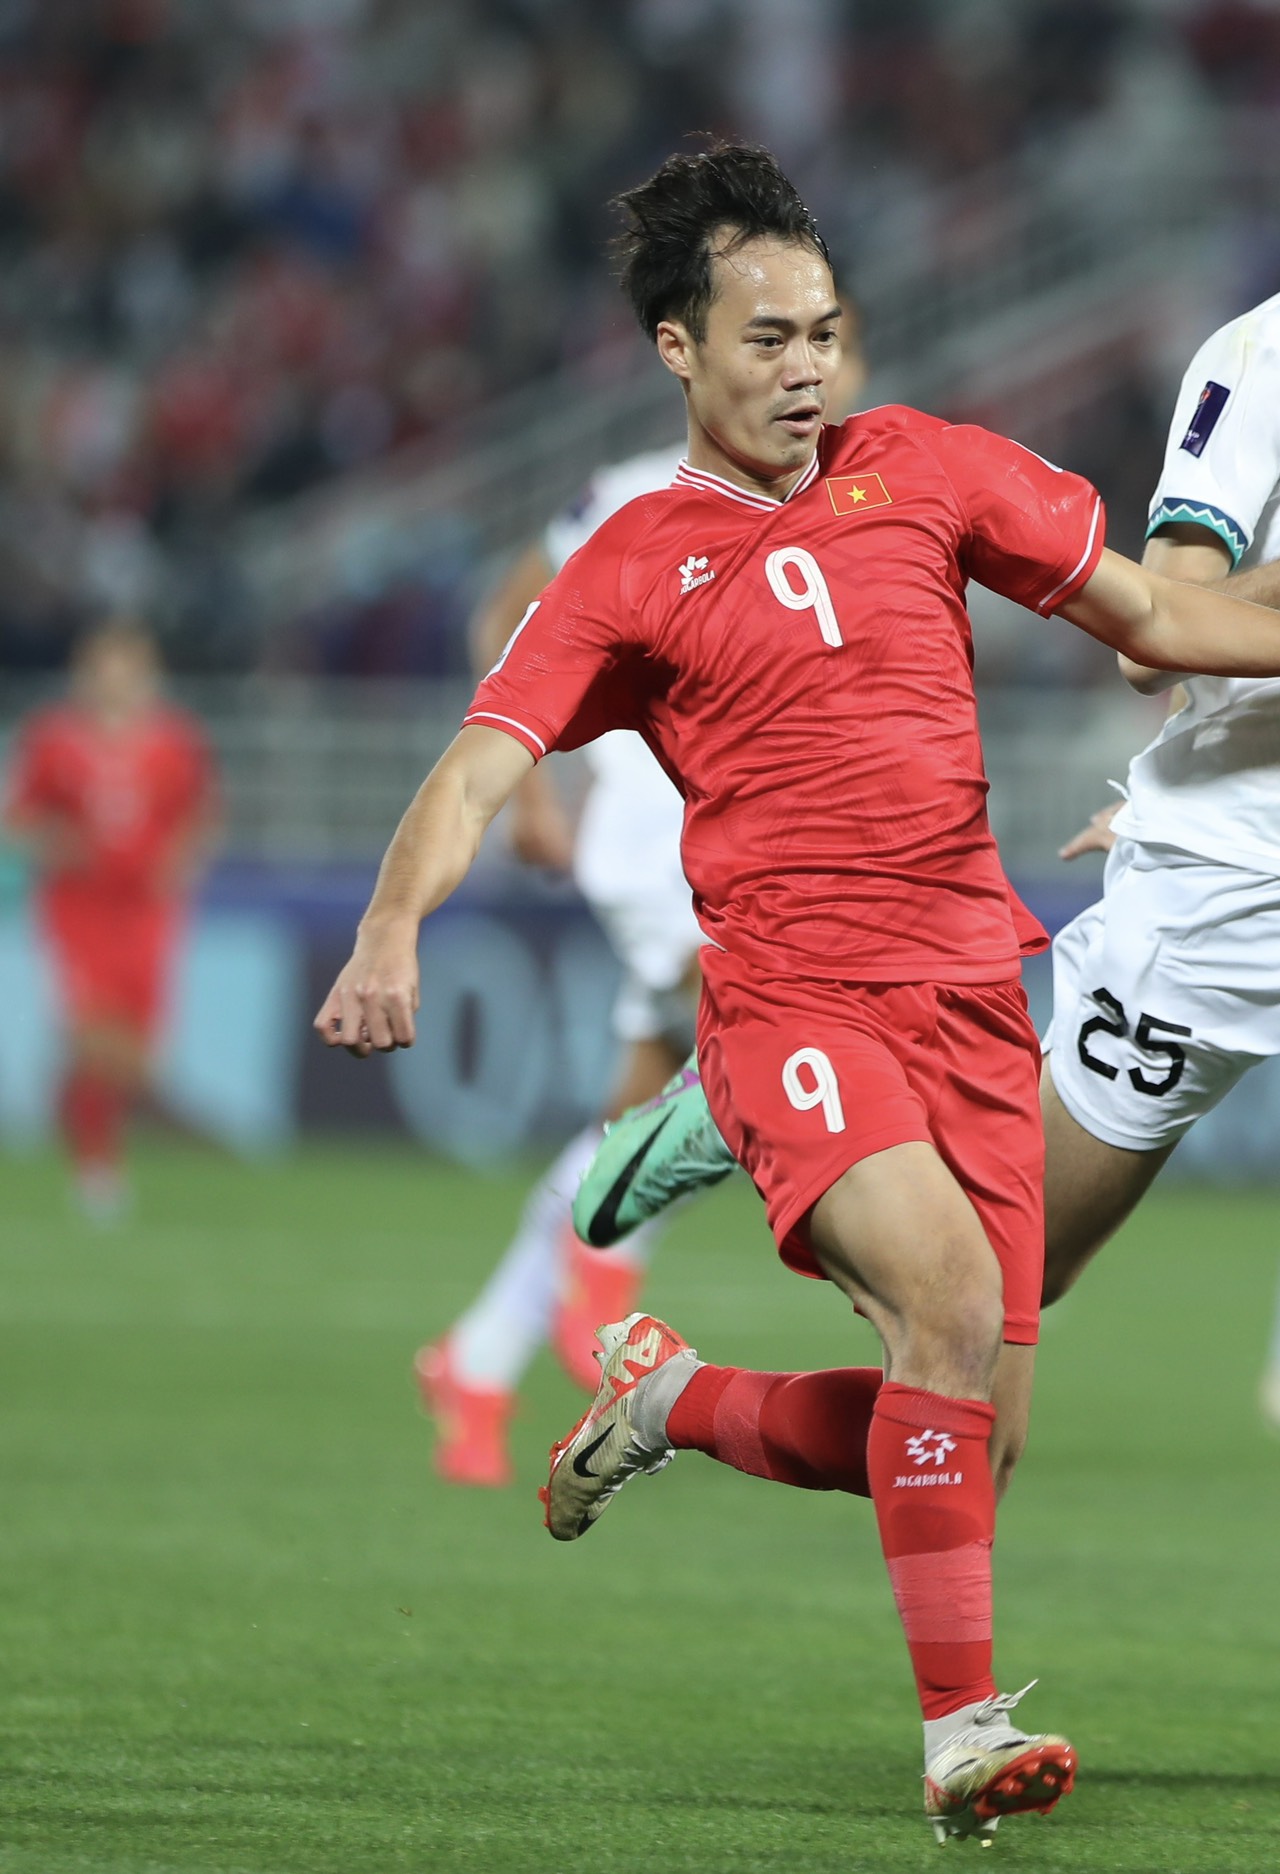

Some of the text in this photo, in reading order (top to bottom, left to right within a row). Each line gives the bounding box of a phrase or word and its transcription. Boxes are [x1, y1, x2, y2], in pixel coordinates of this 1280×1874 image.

[764, 545, 844, 648] 9
[781, 1046, 847, 1134] 9
[1078, 986, 1192, 1098] 25
